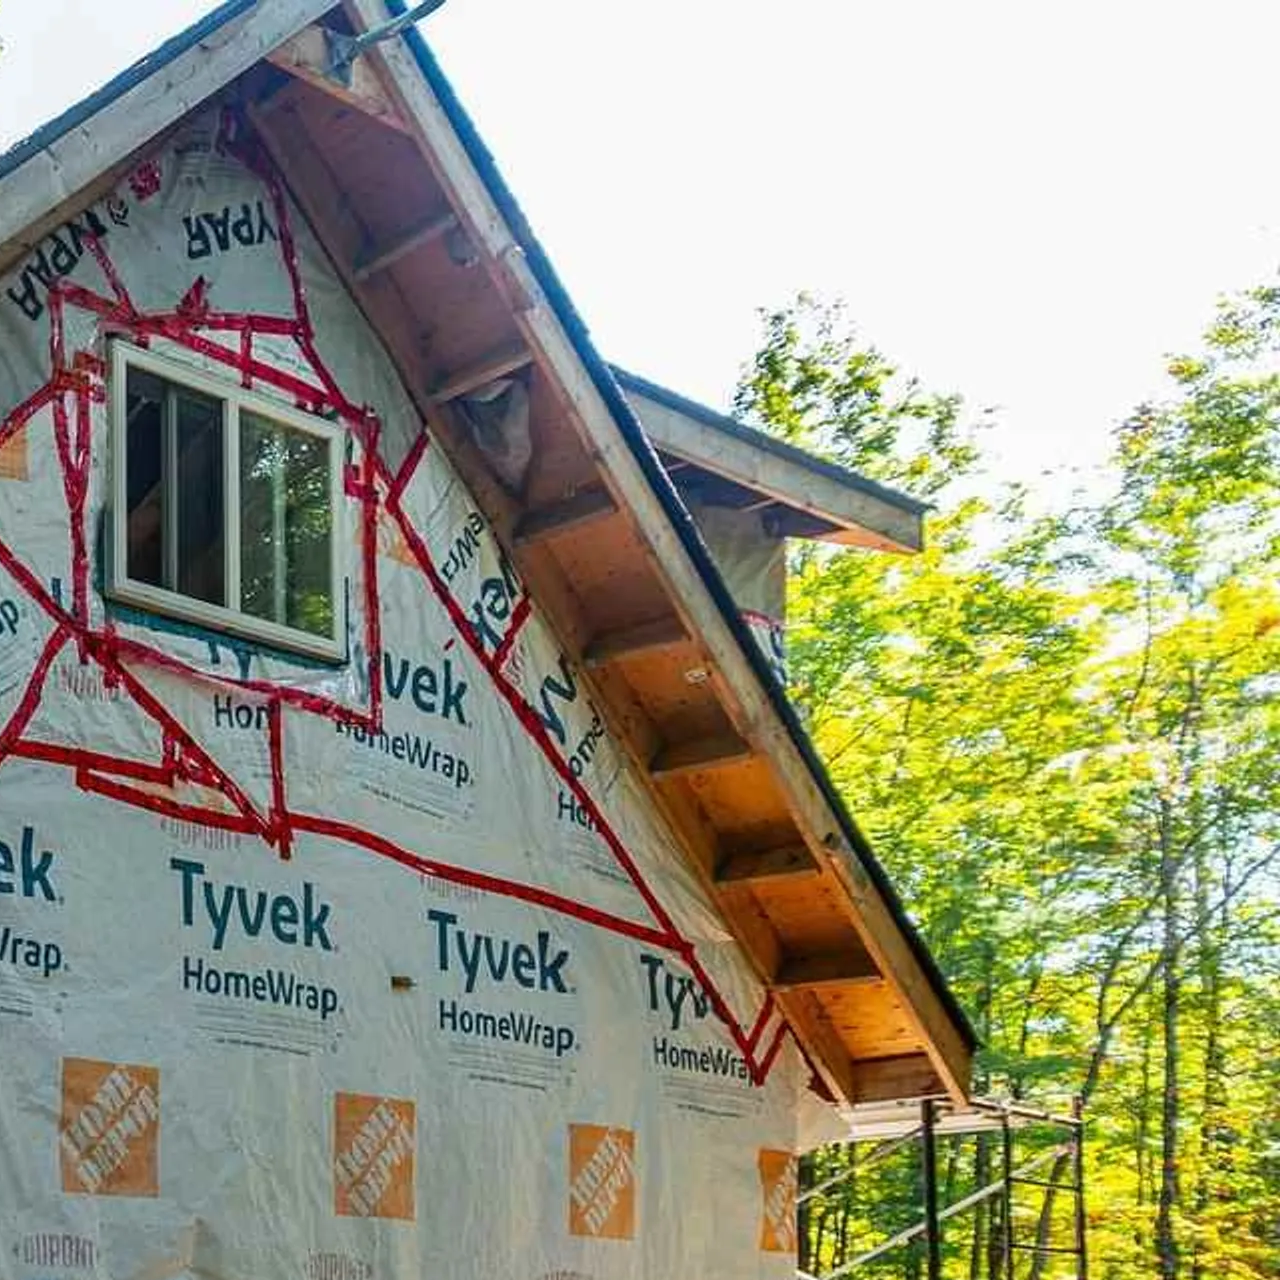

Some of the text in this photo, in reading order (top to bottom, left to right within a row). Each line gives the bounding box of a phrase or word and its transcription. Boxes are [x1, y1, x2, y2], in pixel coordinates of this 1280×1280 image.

[182, 200, 278, 260] YPAR
[170, 857, 334, 951] Tyvek
[427, 909, 571, 994] Tyvek
[183, 956, 339, 1019] HomeWrap
[439, 1000, 575, 1058] HomeWrap
